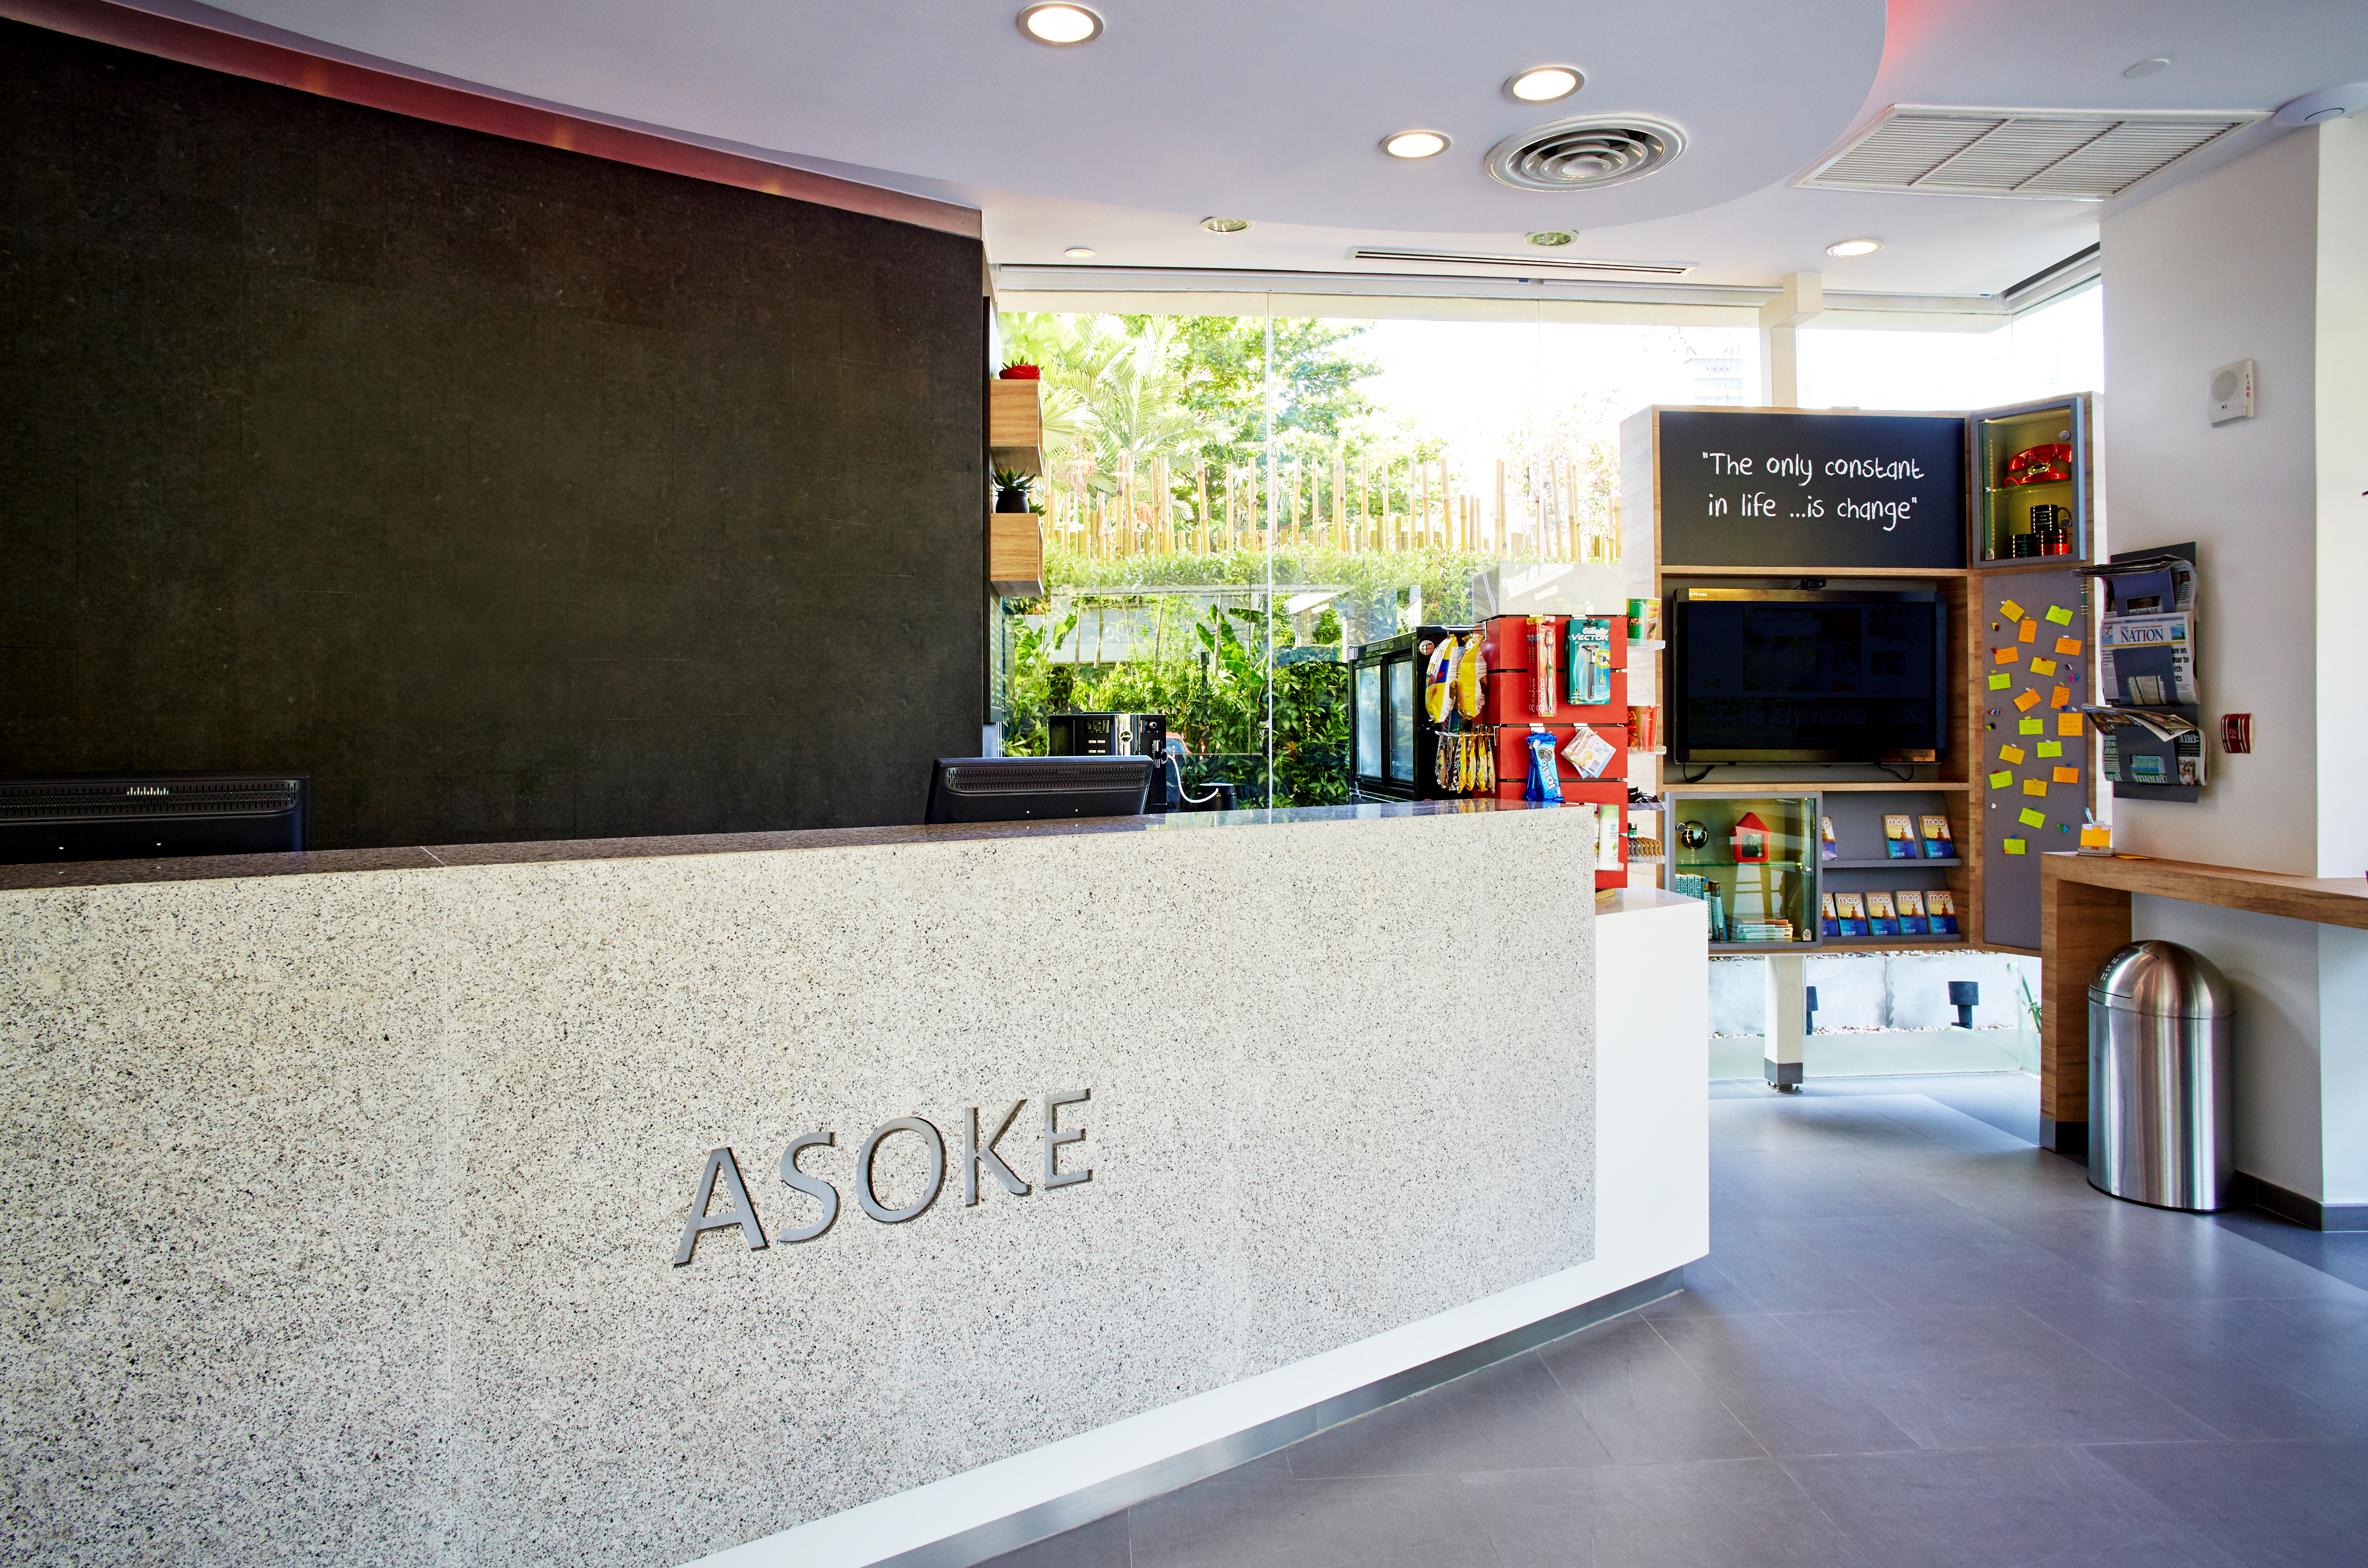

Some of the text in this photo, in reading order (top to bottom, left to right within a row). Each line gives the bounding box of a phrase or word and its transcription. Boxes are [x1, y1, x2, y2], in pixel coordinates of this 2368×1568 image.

[1703, 452, 1924, 486] "The only constant
[1709, 494, 1727, 517] in
[1742, 492, 1776, 516] life
[1837, 497, 1917, 531] change"
[1571, 633, 1609, 641] VECTOR
[2120, 629, 2163, 642] NATION
[1887, 818, 1909, 828] map
[1924, 819, 1945, 828] map
[1822, 896, 1831, 906] ap
[1837, 896, 1859, 906] map
[1868, 896, 1890, 906] map
[1898, 894, 1920, 904] map
[1929, 894, 1950, 903] map
[673, 1088, 1093, 1267] ASOKE
